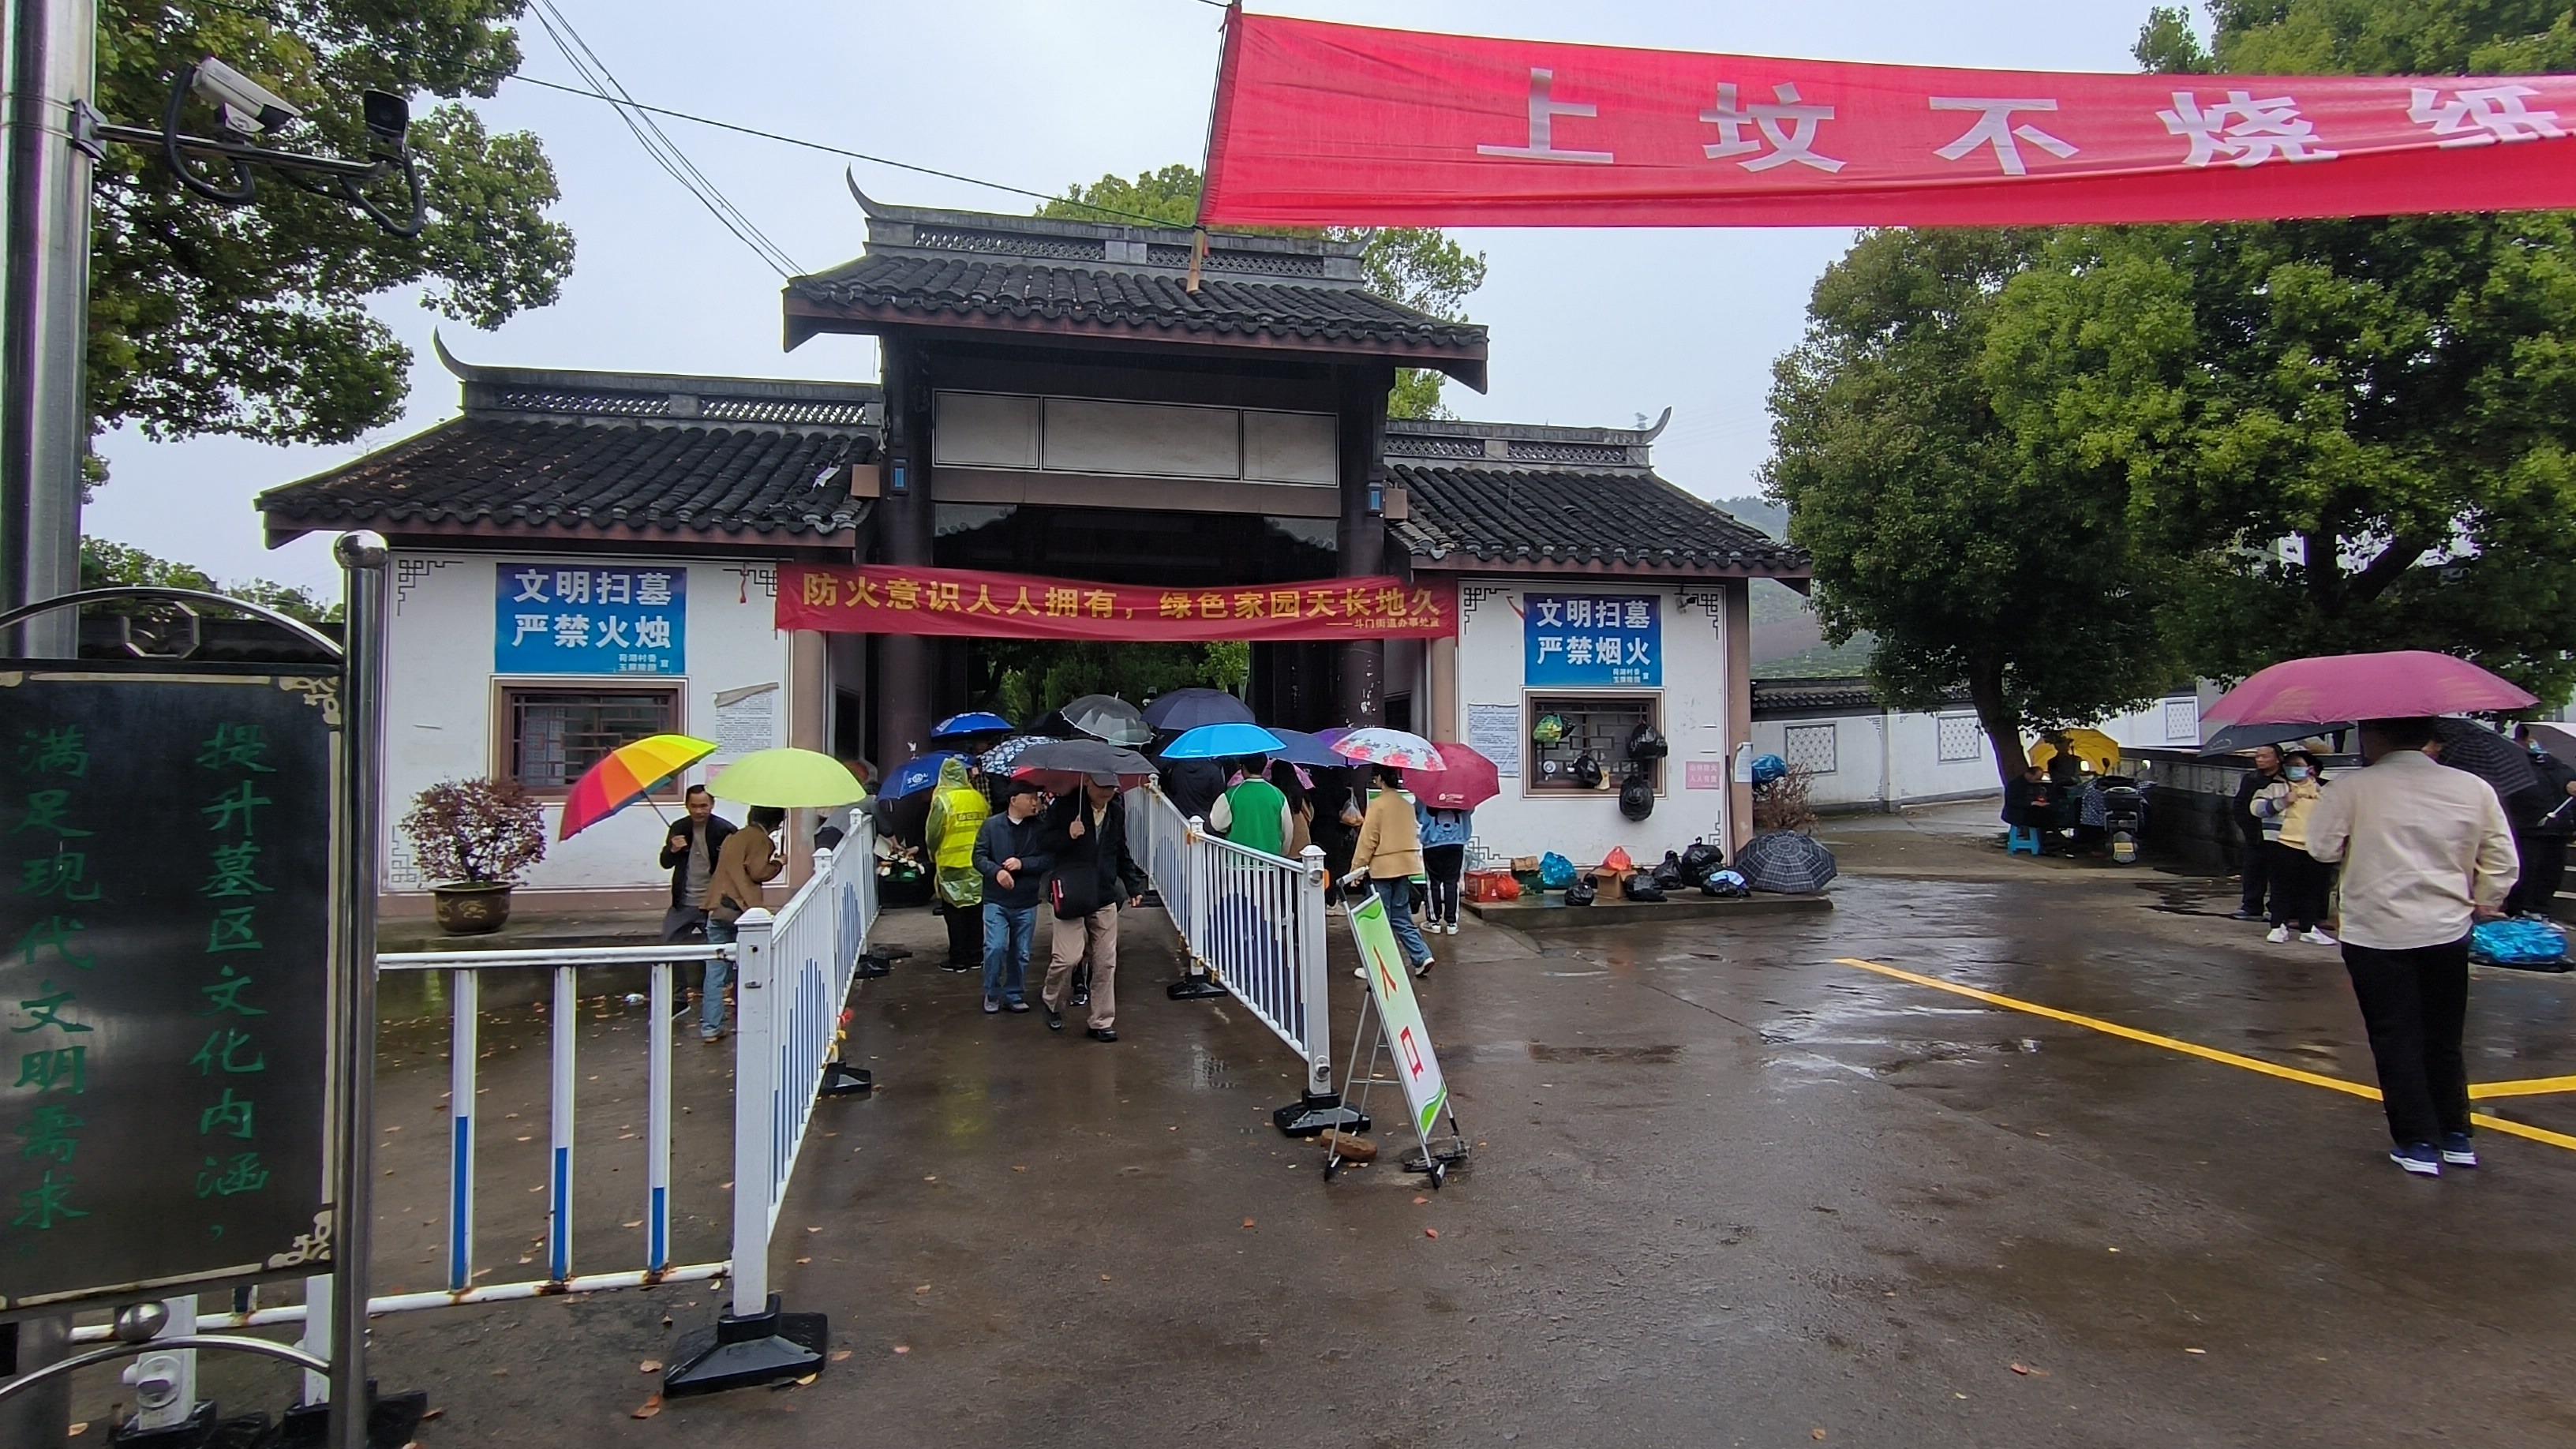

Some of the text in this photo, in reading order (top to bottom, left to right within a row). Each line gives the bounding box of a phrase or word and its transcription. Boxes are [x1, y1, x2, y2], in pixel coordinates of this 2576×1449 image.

[1476, 67, 2568, 174] 上坟不烧纸
[512, 567, 672, 606] 文明扫墓
[511, 613, 672, 649] 严禁火烛
[1537, 597, 1651, 630] 文明扫墓
[1537, 636, 1652, 665] 严禁烟火
